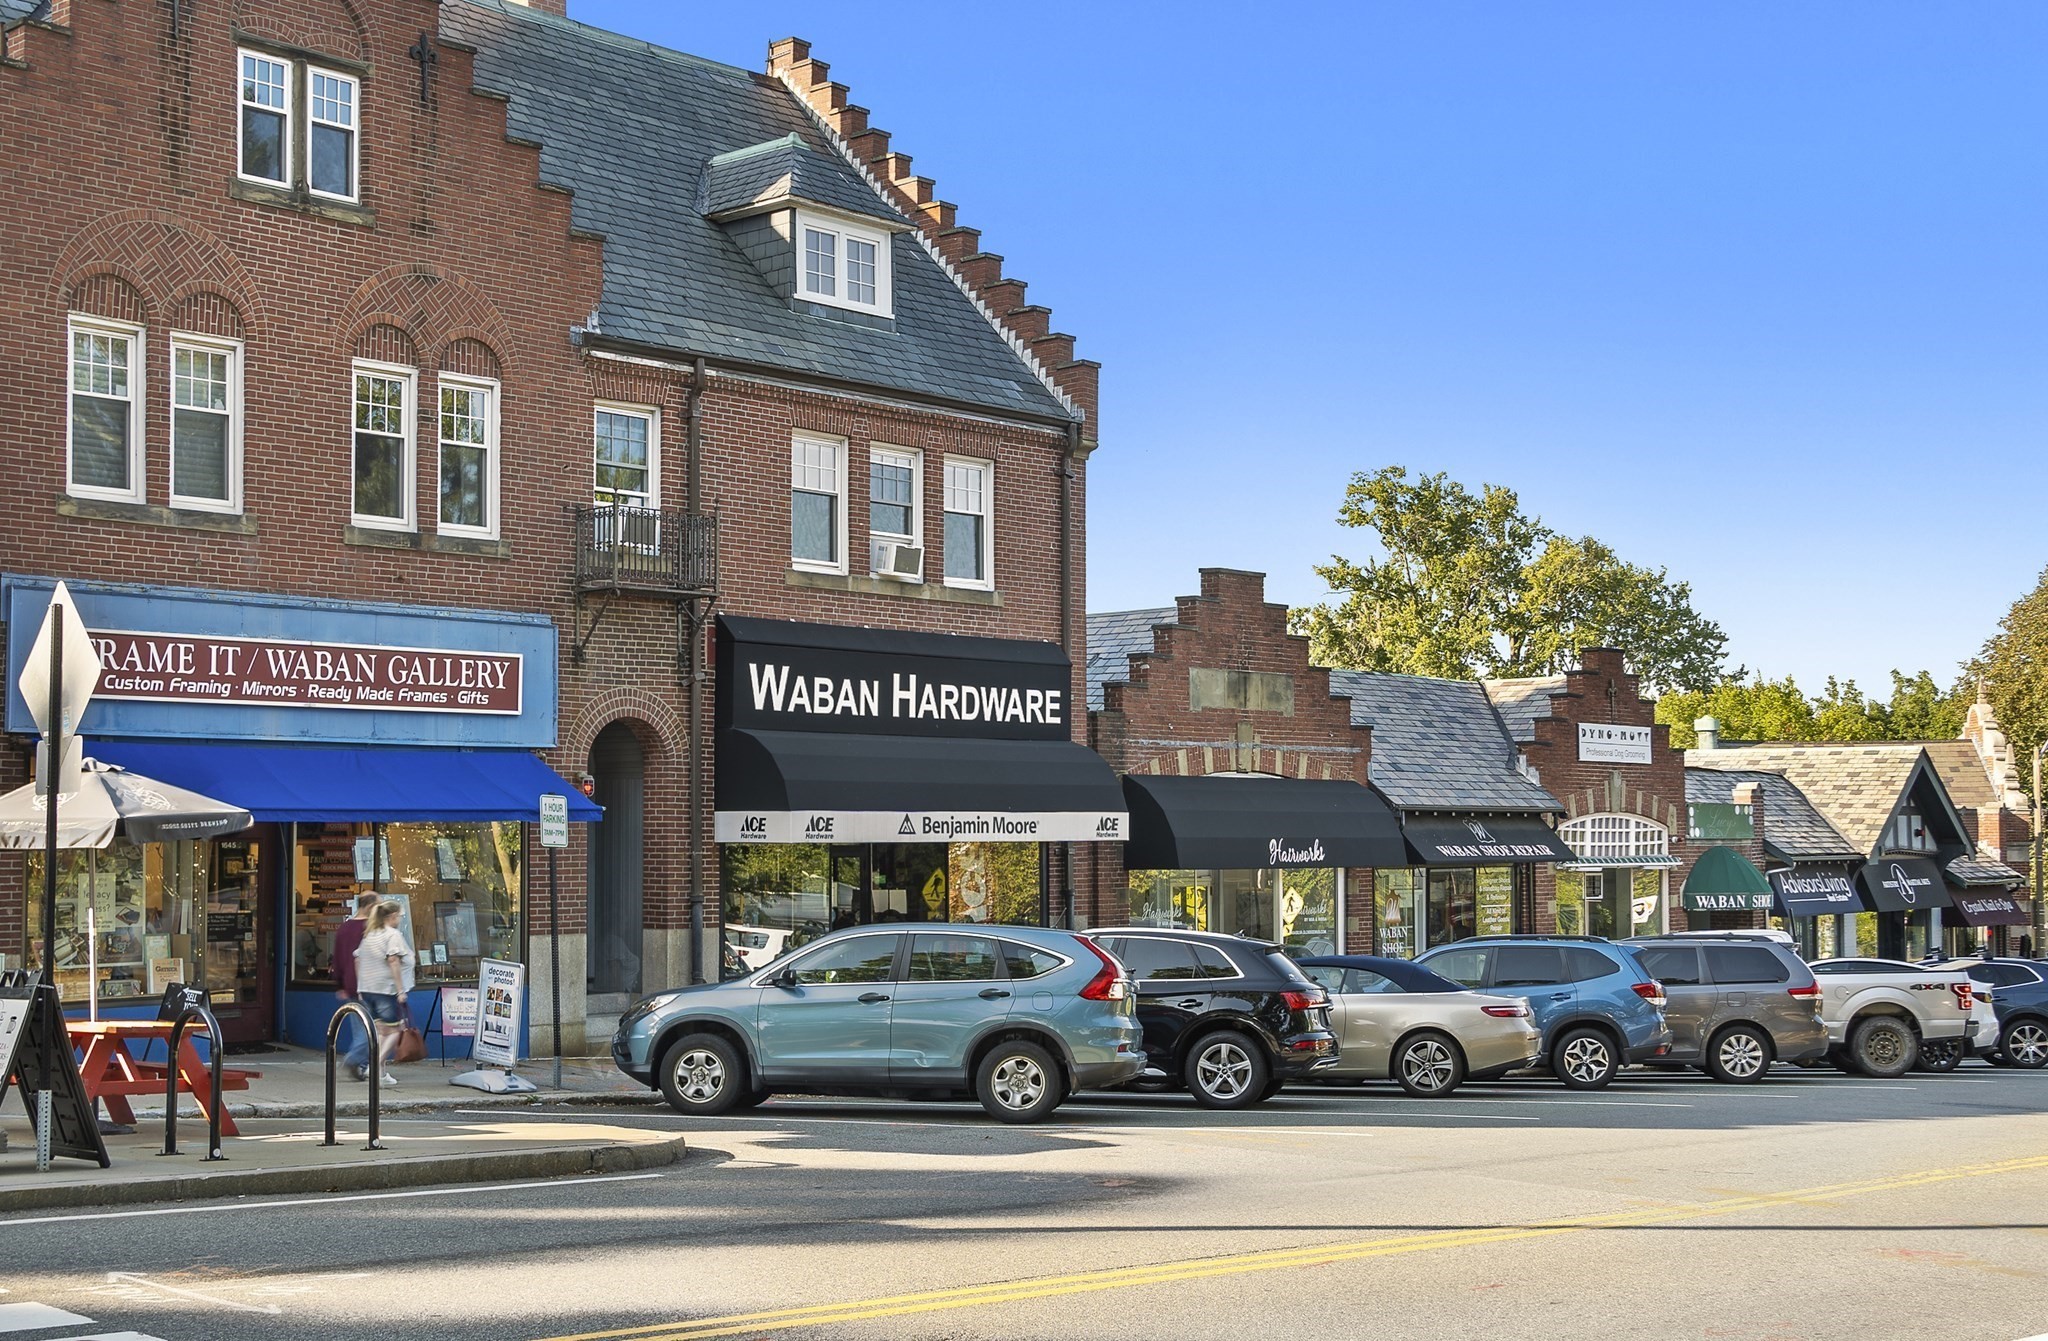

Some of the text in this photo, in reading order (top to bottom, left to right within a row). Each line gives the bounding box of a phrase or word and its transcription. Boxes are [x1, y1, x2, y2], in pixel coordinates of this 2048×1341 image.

[91, 637, 196, 675] RAME
[208, 644, 241, 676] IT
[265, 647, 378, 684] WABAN
[387, 654, 511, 690] GALLERY
[104, 674, 489, 705] Custom Framing Mirrors Ready Made Frames Gifts
[748, 663, 1062, 724] WABAN HARDWARE
[1586, 747, 1646, 760] Professional Dog Grooming
[548, 802, 564, 812] HOUR
[543, 813, 565, 825] PARKING
[740, 814, 767, 832] ACE
[805, 814, 834, 832] ACE
[1095, 816, 1119, 832] ACE
[922, 815, 1038, 839] Benjamin Moore
[740, 832, 767, 840] Hardware
[805, 832, 834, 840] Hardware
[1269, 838, 1326, 866] Hairworks
[1436, 844, 1556, 857] WABAN SHOE REPAIR
[83, 890, 111, 900] leacy
[1695, 895, 1746, 909] WABAN
[1380, 927, 1408, 938] WABAN
[1382, 942, 1405, 954] SHOE
[488, 966, 515, 979] decorate
